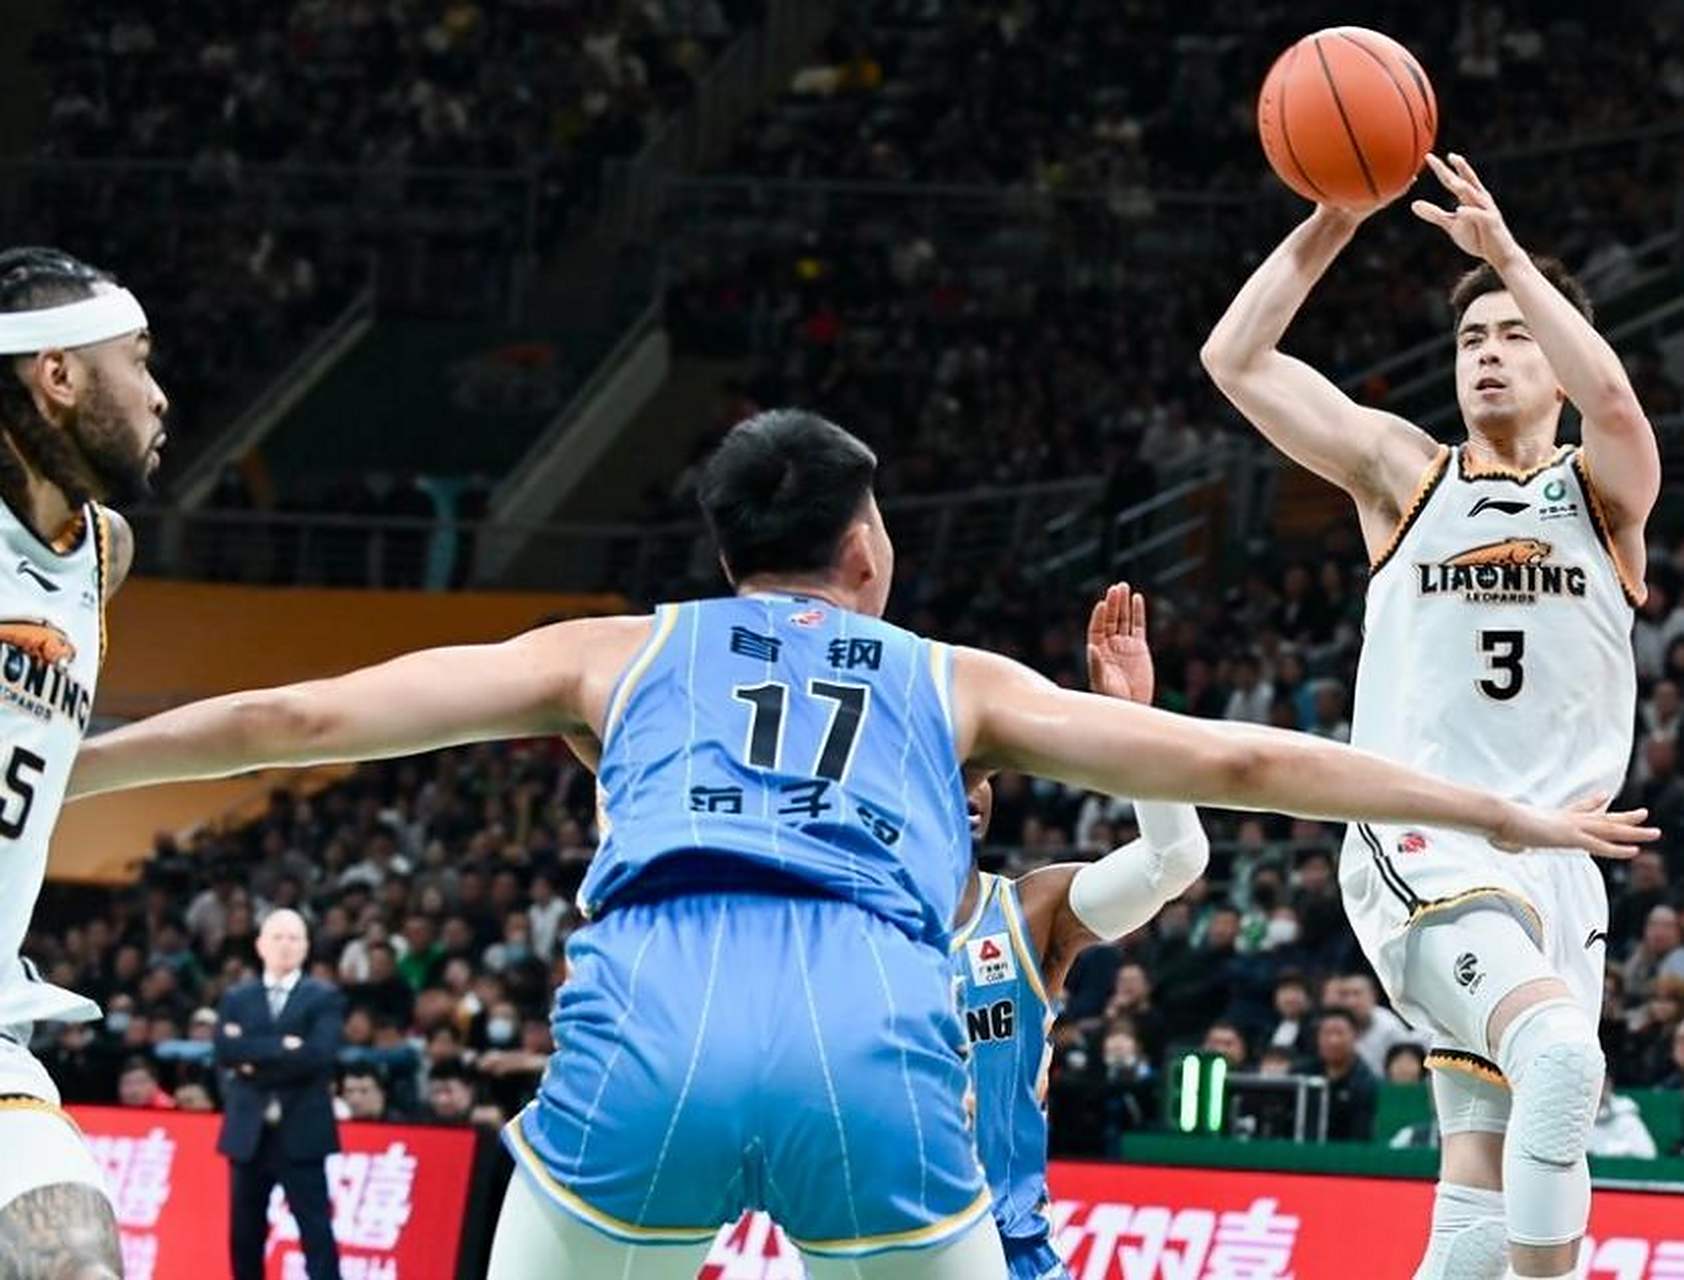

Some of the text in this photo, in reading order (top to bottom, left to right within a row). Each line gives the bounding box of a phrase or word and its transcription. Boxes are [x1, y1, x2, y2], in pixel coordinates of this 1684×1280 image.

[1416, 563, 1586, 598] LIAONING
[1480, 629, 1525, 701] 3
[732, 678, 871, 786] 17
[0, 746, 46, 840] 5
[966, 1000, 1014, 1043] NG
